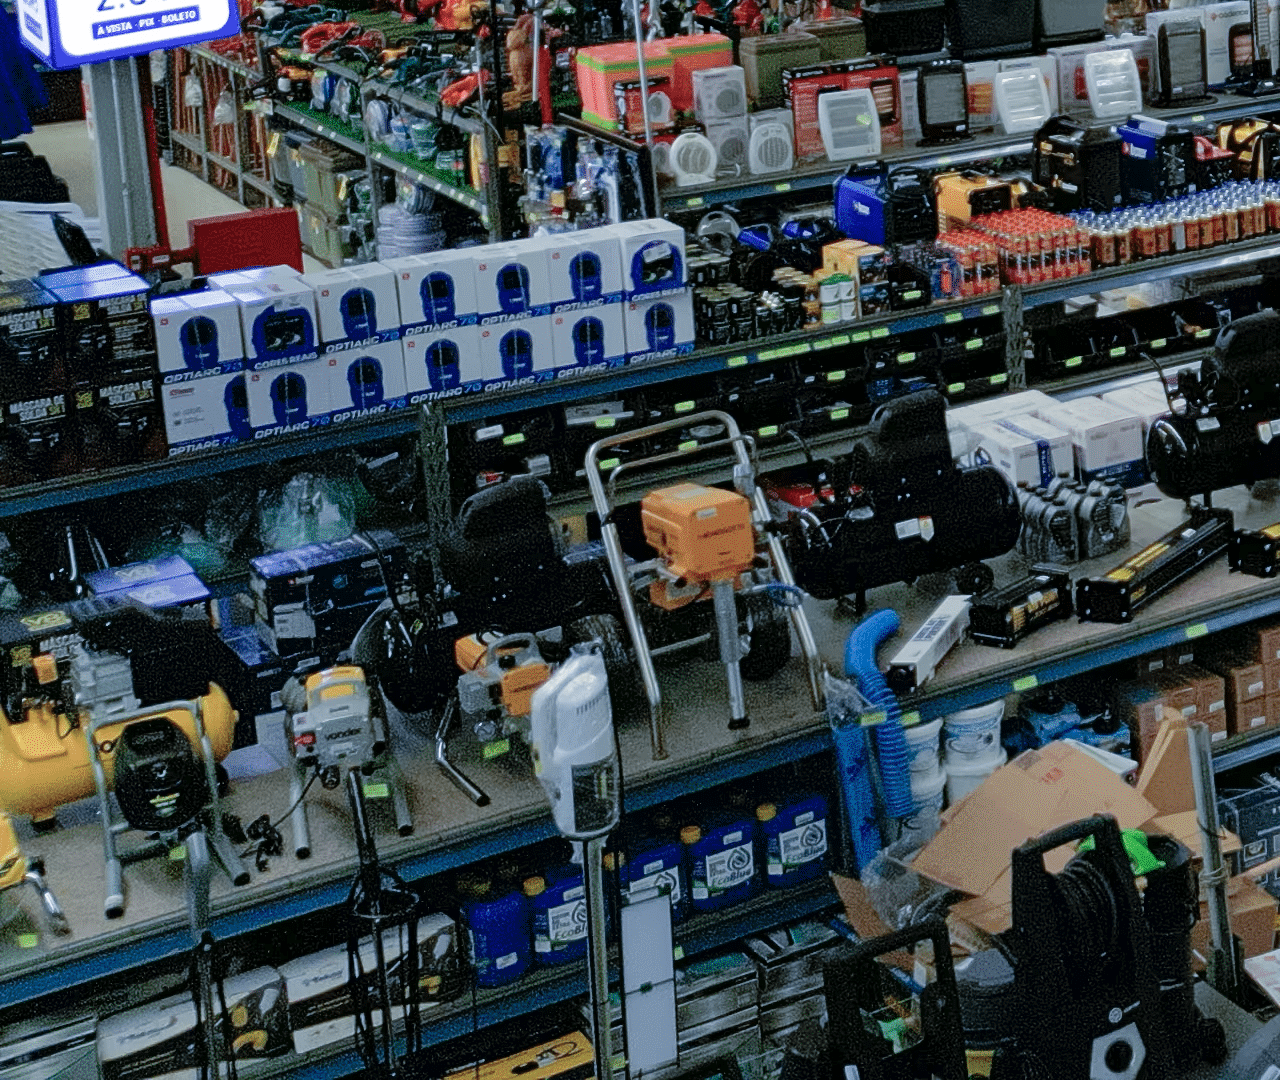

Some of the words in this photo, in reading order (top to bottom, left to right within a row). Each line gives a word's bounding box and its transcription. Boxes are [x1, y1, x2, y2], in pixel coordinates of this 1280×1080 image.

[161, 9, 197, 25] BOLETO
[554, 295, 604, 314] OPTIARC
[480, 309, 532, 327] OPTIARC
[405, 319, 458, 338] OPTIARC
[325, 335, 380, 355] OPTIARC
[163, 366, 222, 386] OPTIARC
[484, 374, 536, 392] OPTIARC
[410, 386, 463, 405] OPTIARC
[333, 403, 387, 423] OPTIARC
[255, 419, 310, 440] OPTIARC
[168, 438, 220, 457] OPTIARC
[324, 727, 362, 741] vonder
